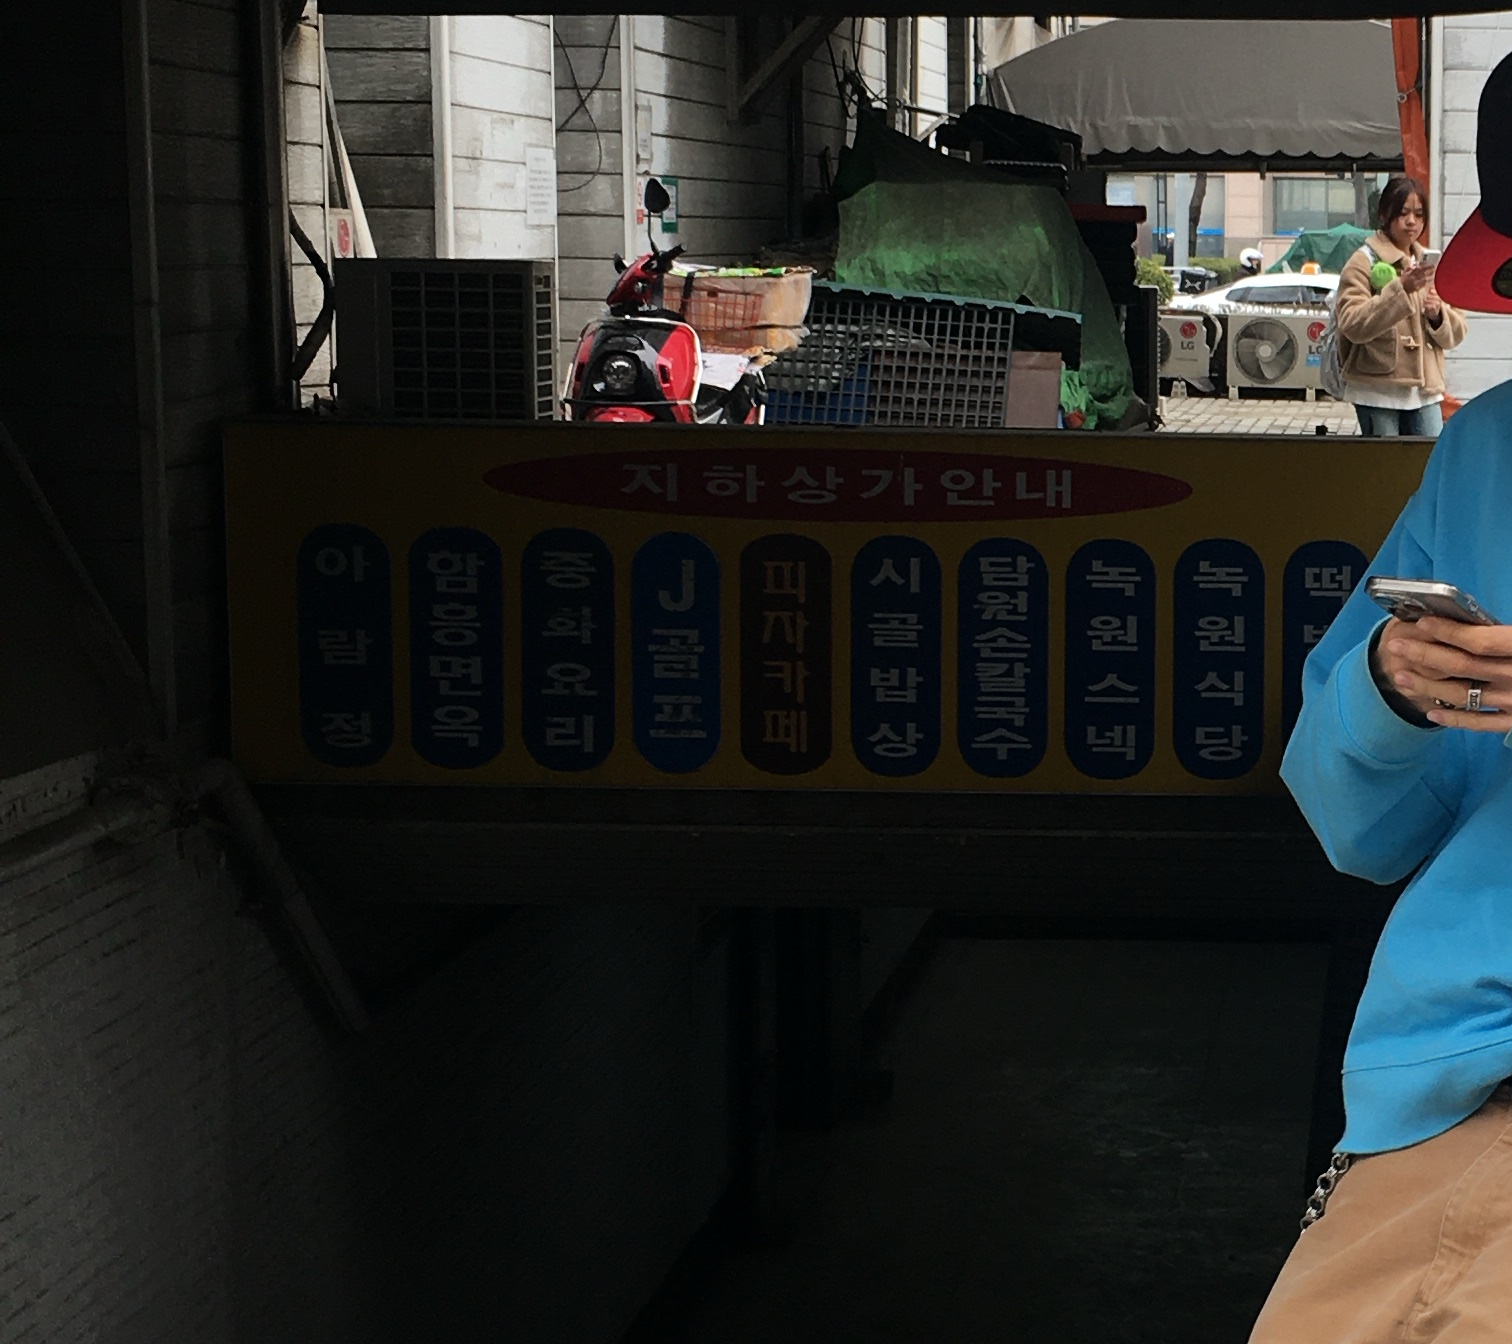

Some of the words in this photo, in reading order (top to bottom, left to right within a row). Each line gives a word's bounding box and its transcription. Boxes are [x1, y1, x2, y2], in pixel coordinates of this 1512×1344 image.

[1181, 341, 1194, 350] LG
[315, 545, 373, 748] 아람정
[426, 550, 485, 748] 함흥면옥
[539, 551, 599, 753] 중화요리
[762, 560, 811, 754] 피자카페
[866, 557, 924, 758] 시골밥상
[970, 555, 1035, 760] 담원손칼국수
[1084, 559, 1142, 761] 녹원스넥
[1193, 560, 1249, 761] 녹원식당
